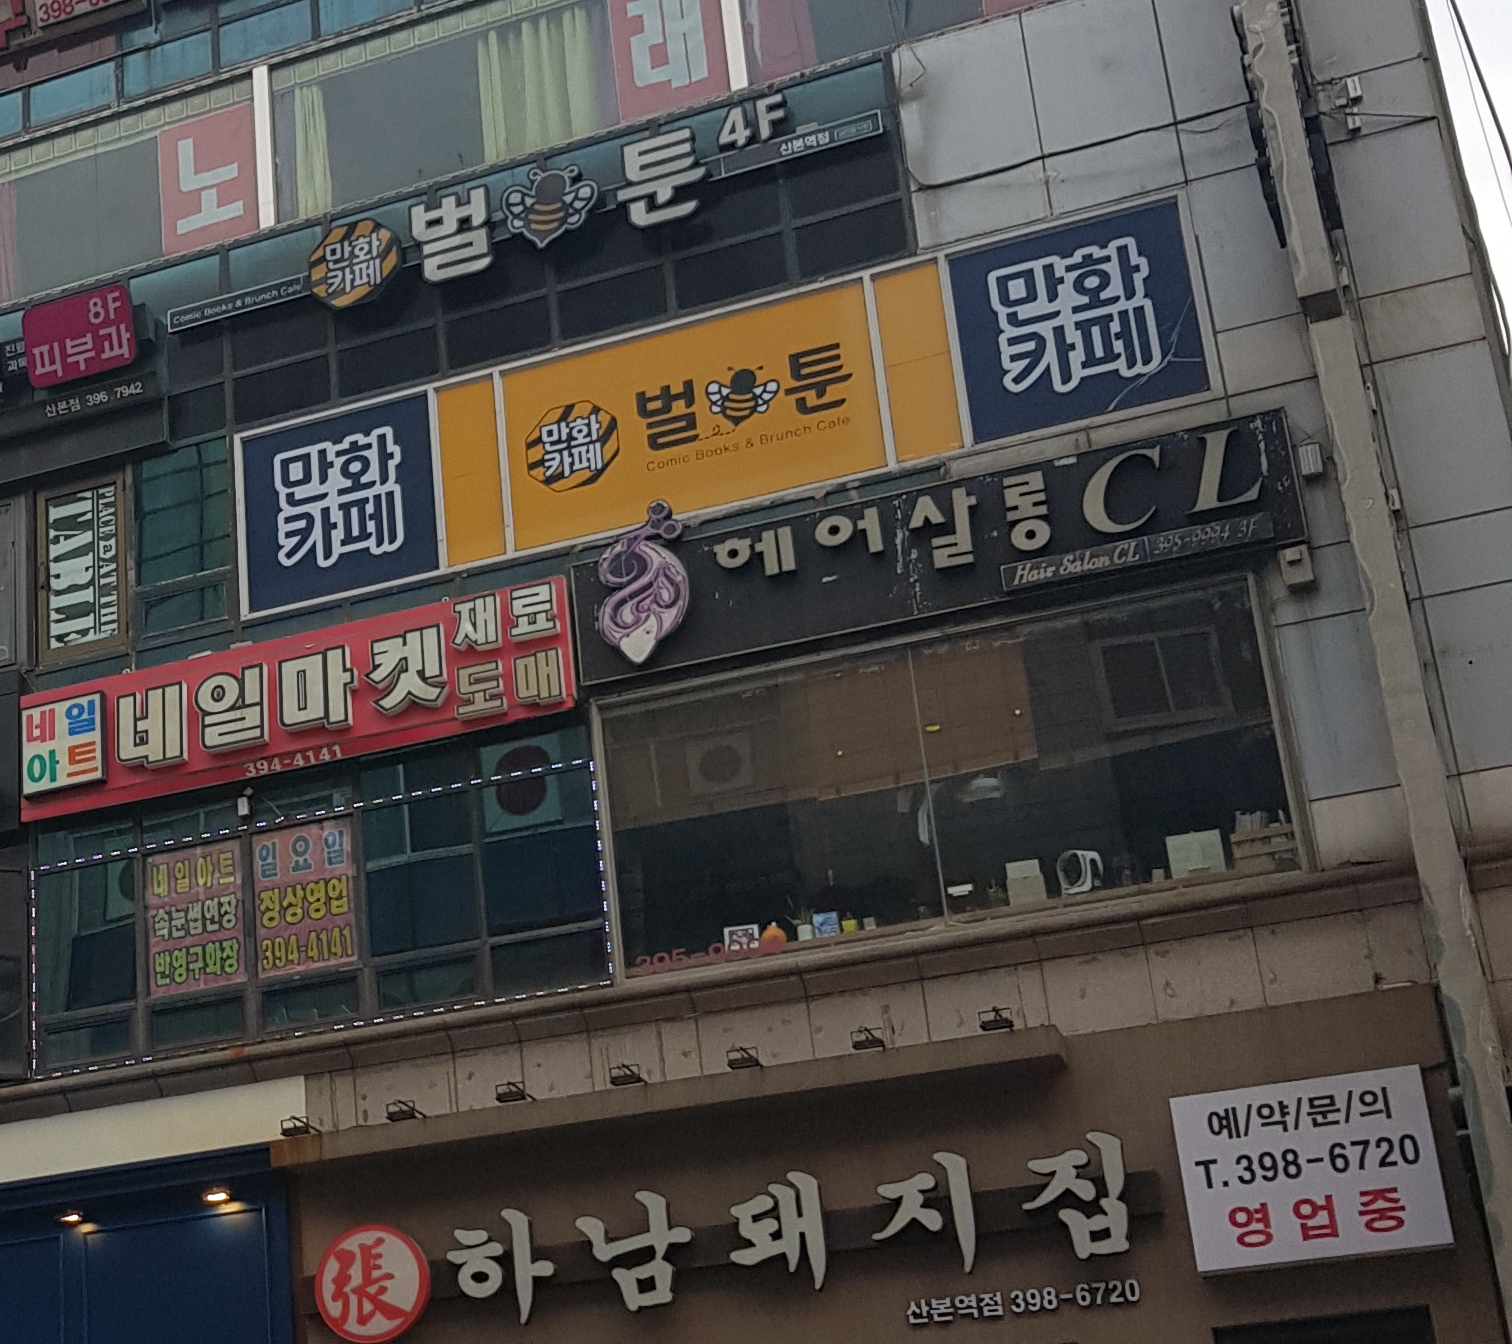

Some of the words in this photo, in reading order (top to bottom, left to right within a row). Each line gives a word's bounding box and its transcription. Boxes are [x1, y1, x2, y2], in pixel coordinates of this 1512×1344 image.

[718, 93, 788, 148] 4F
[324, 232, 382, 269] 만화
[325, 258, 382, 296] 카페
[985, 237, 1149, 325] 만화
[88, 291, 122, 325] 8F
[31, 323, 131, 378] 피부과
[1002, 297, 1163, 395] 카페
[45, 396, 81, 418] 산본점
[539, 413, 602, 452] 만화
[274, 423, 403, 500] 만화
[542, 441, 604, 479] 카페
[645, 454, 691, 473] Comic
[694, 441, 740, 462] Books
[759, 425, 813, 446] Brunch
[711, 471, 1053, 578] 헤어살롱
[1081, 425, 1265, 535] CL
[281, 491, 405, 570] 카페
[1011, 563, 1056, 586] Hair
[1058, 551, 1111, 576] Salon
[1113, 542, 1140, 565] CL
[450, 581, 560, 652] 재료
[114, 622, 450, 768] 네일마켓
[453, 648, 566, 721] 도매
[25, 698, 97, 744] 네일
[26, 740, 98, 785] 아트
[244, 743, 345, 780] 394-4141
[257, 830, 347, 881] 일요일
[259, 874, 350, 929] 정상영업
[154, 937, 240, 988] 반영구화장
[260, 925, 354, 972] 394-4141
[444, 1129, 1133, 1327] 하남돼지집
[904, 1288, 1006, 1326] 산본역점
[1009, 1276, 1141, 1315] 398-6720
